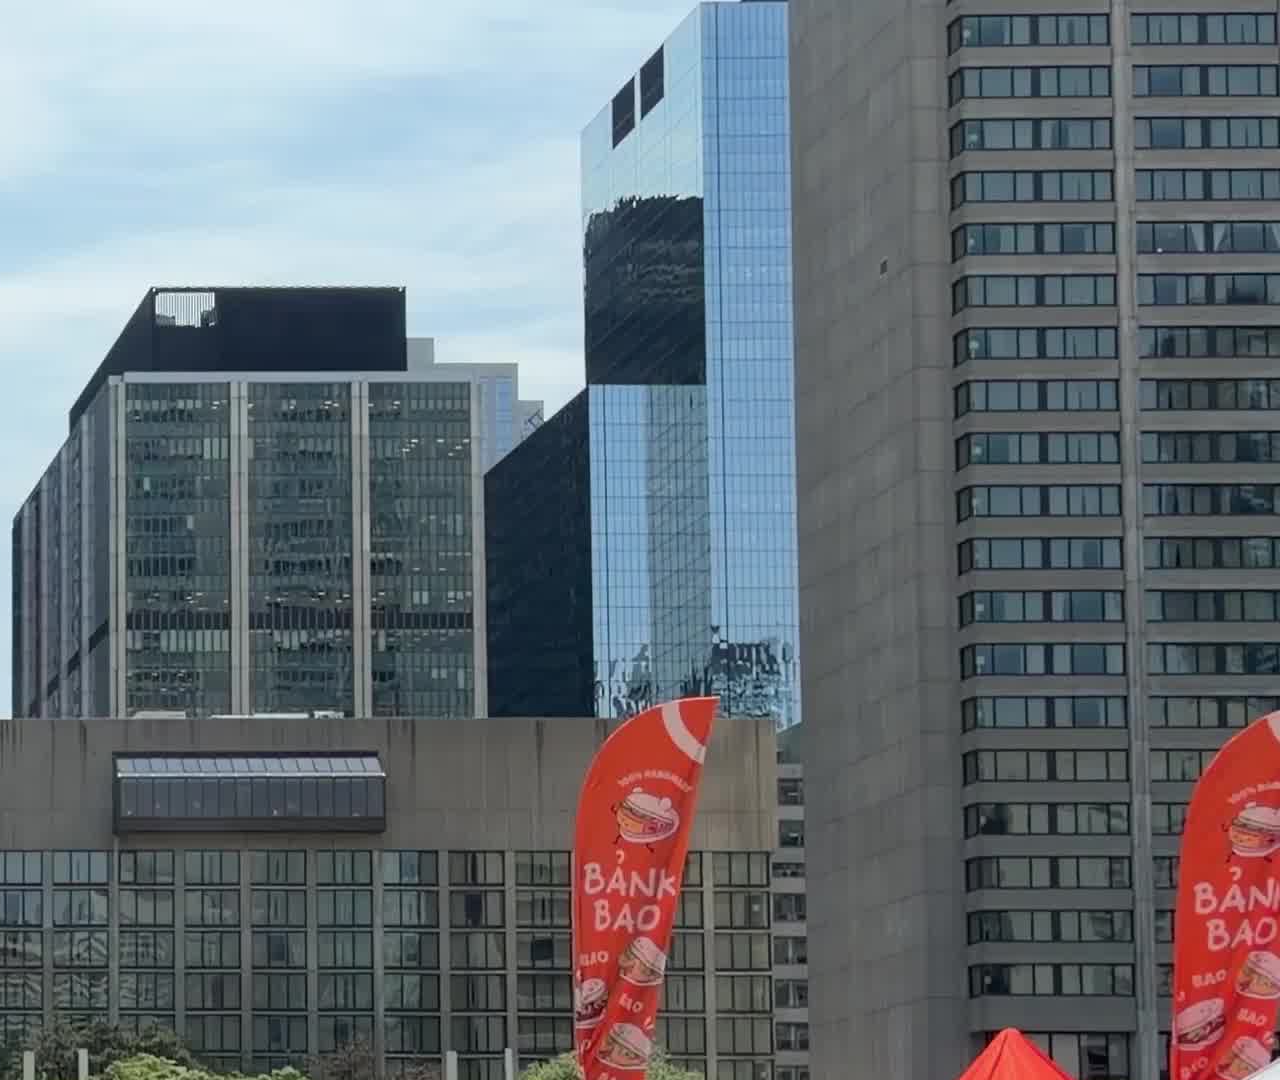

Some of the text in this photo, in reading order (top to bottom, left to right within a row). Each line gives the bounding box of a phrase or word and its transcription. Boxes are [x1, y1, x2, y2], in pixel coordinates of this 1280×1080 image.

[593, 899, 662, 933] BAO
[1205, 915, 1278, 952] BAO
[1192, 969, 1227, 989] BAO
[1236, 1007, 1268, 1027] BAO
